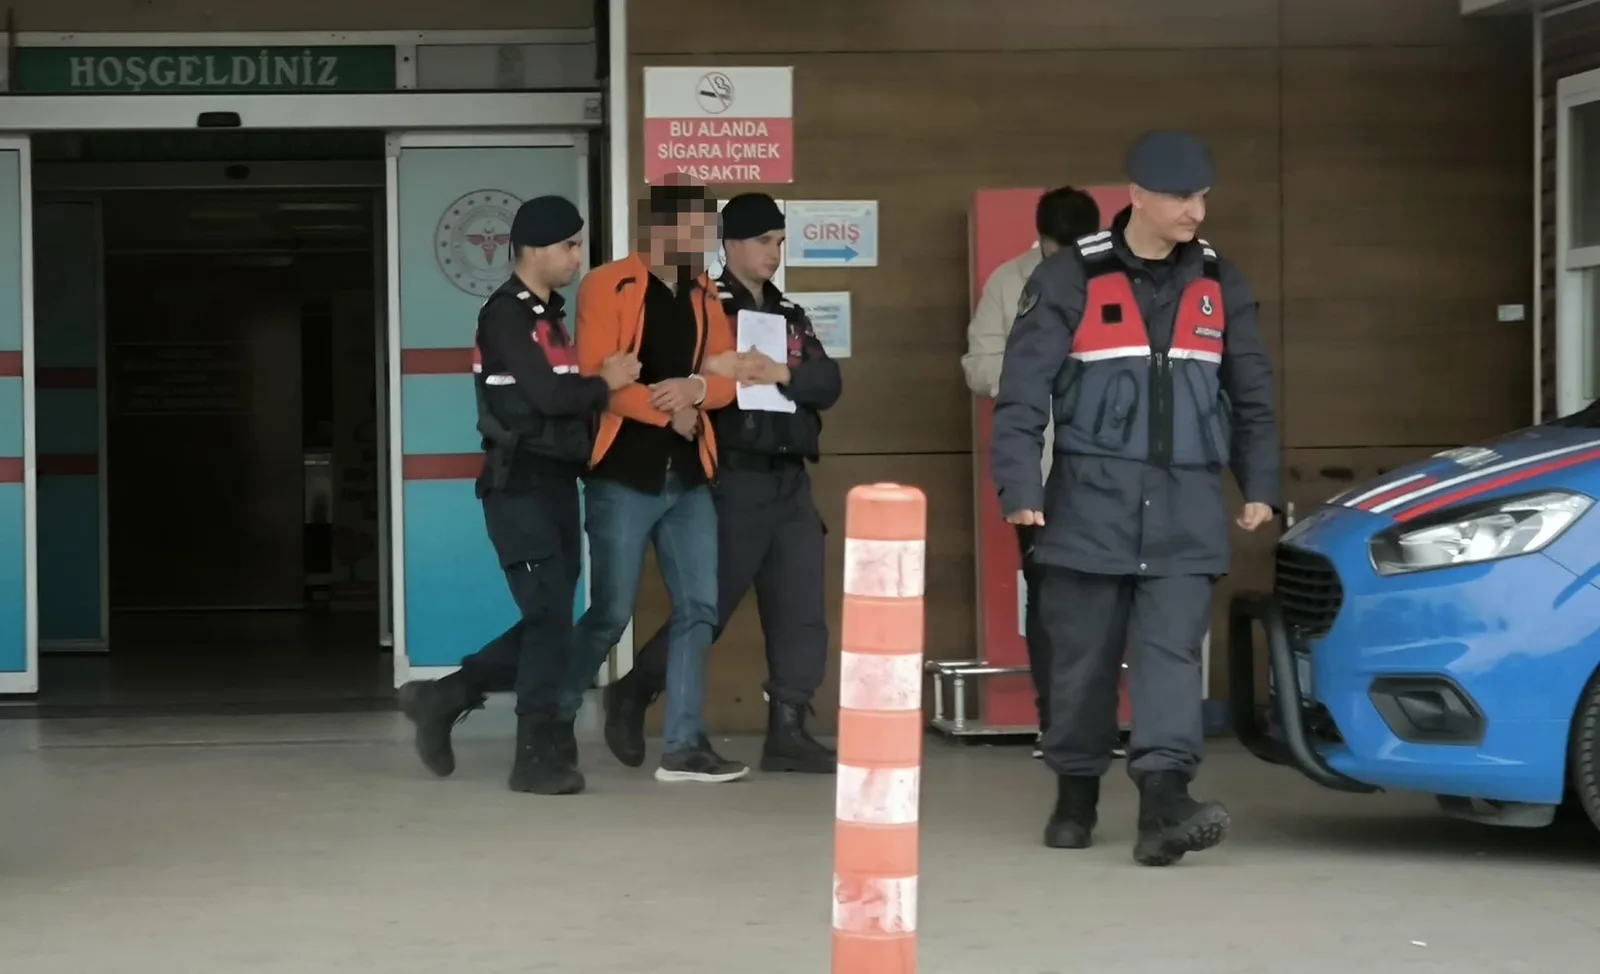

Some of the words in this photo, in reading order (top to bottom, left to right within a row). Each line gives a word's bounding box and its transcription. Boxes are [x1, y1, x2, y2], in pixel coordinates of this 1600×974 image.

[69, 49, 338, 91] HOŞGELDİNİZ
[670, 121, 693, 137] BU
[698, 121, 768, 137] ALANDA
[657, 140, 722, 159] SİGARA
[727, 140, 780, 162] İÇMEK
[803, 220, 860, 244] GİRİŞ
